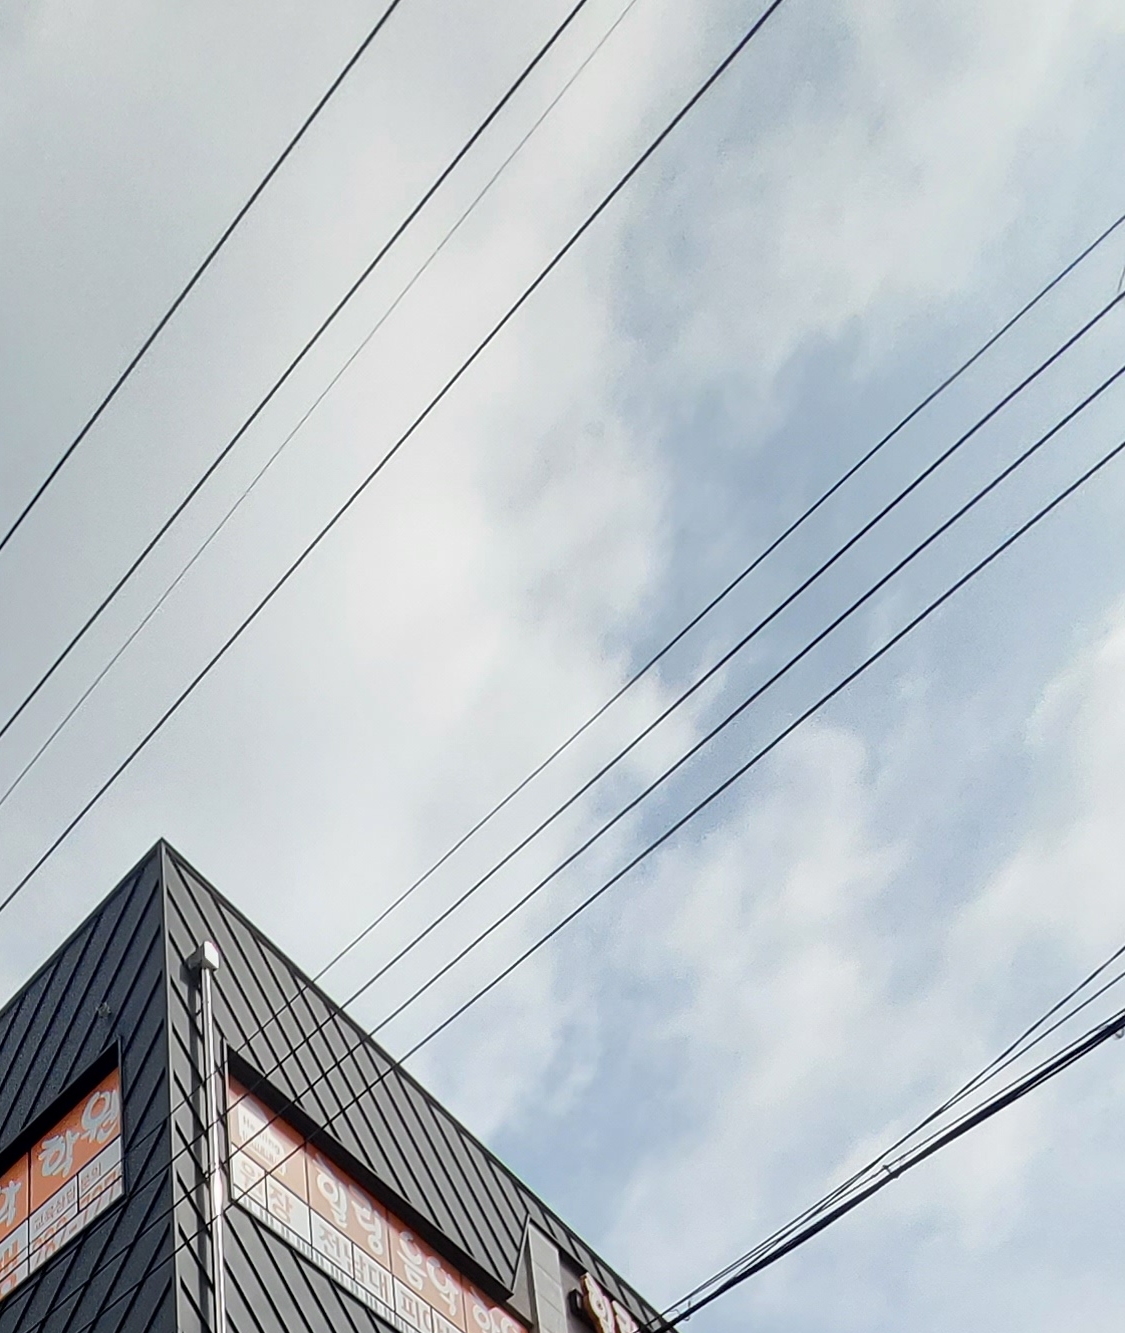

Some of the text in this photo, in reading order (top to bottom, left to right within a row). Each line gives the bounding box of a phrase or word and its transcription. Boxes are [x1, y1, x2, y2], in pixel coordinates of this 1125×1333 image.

[39, 1090, 119, 1178] 학원
[313, 1154, 383, 1254] 힐링
[398, 1231, 458, 1316] 음악
